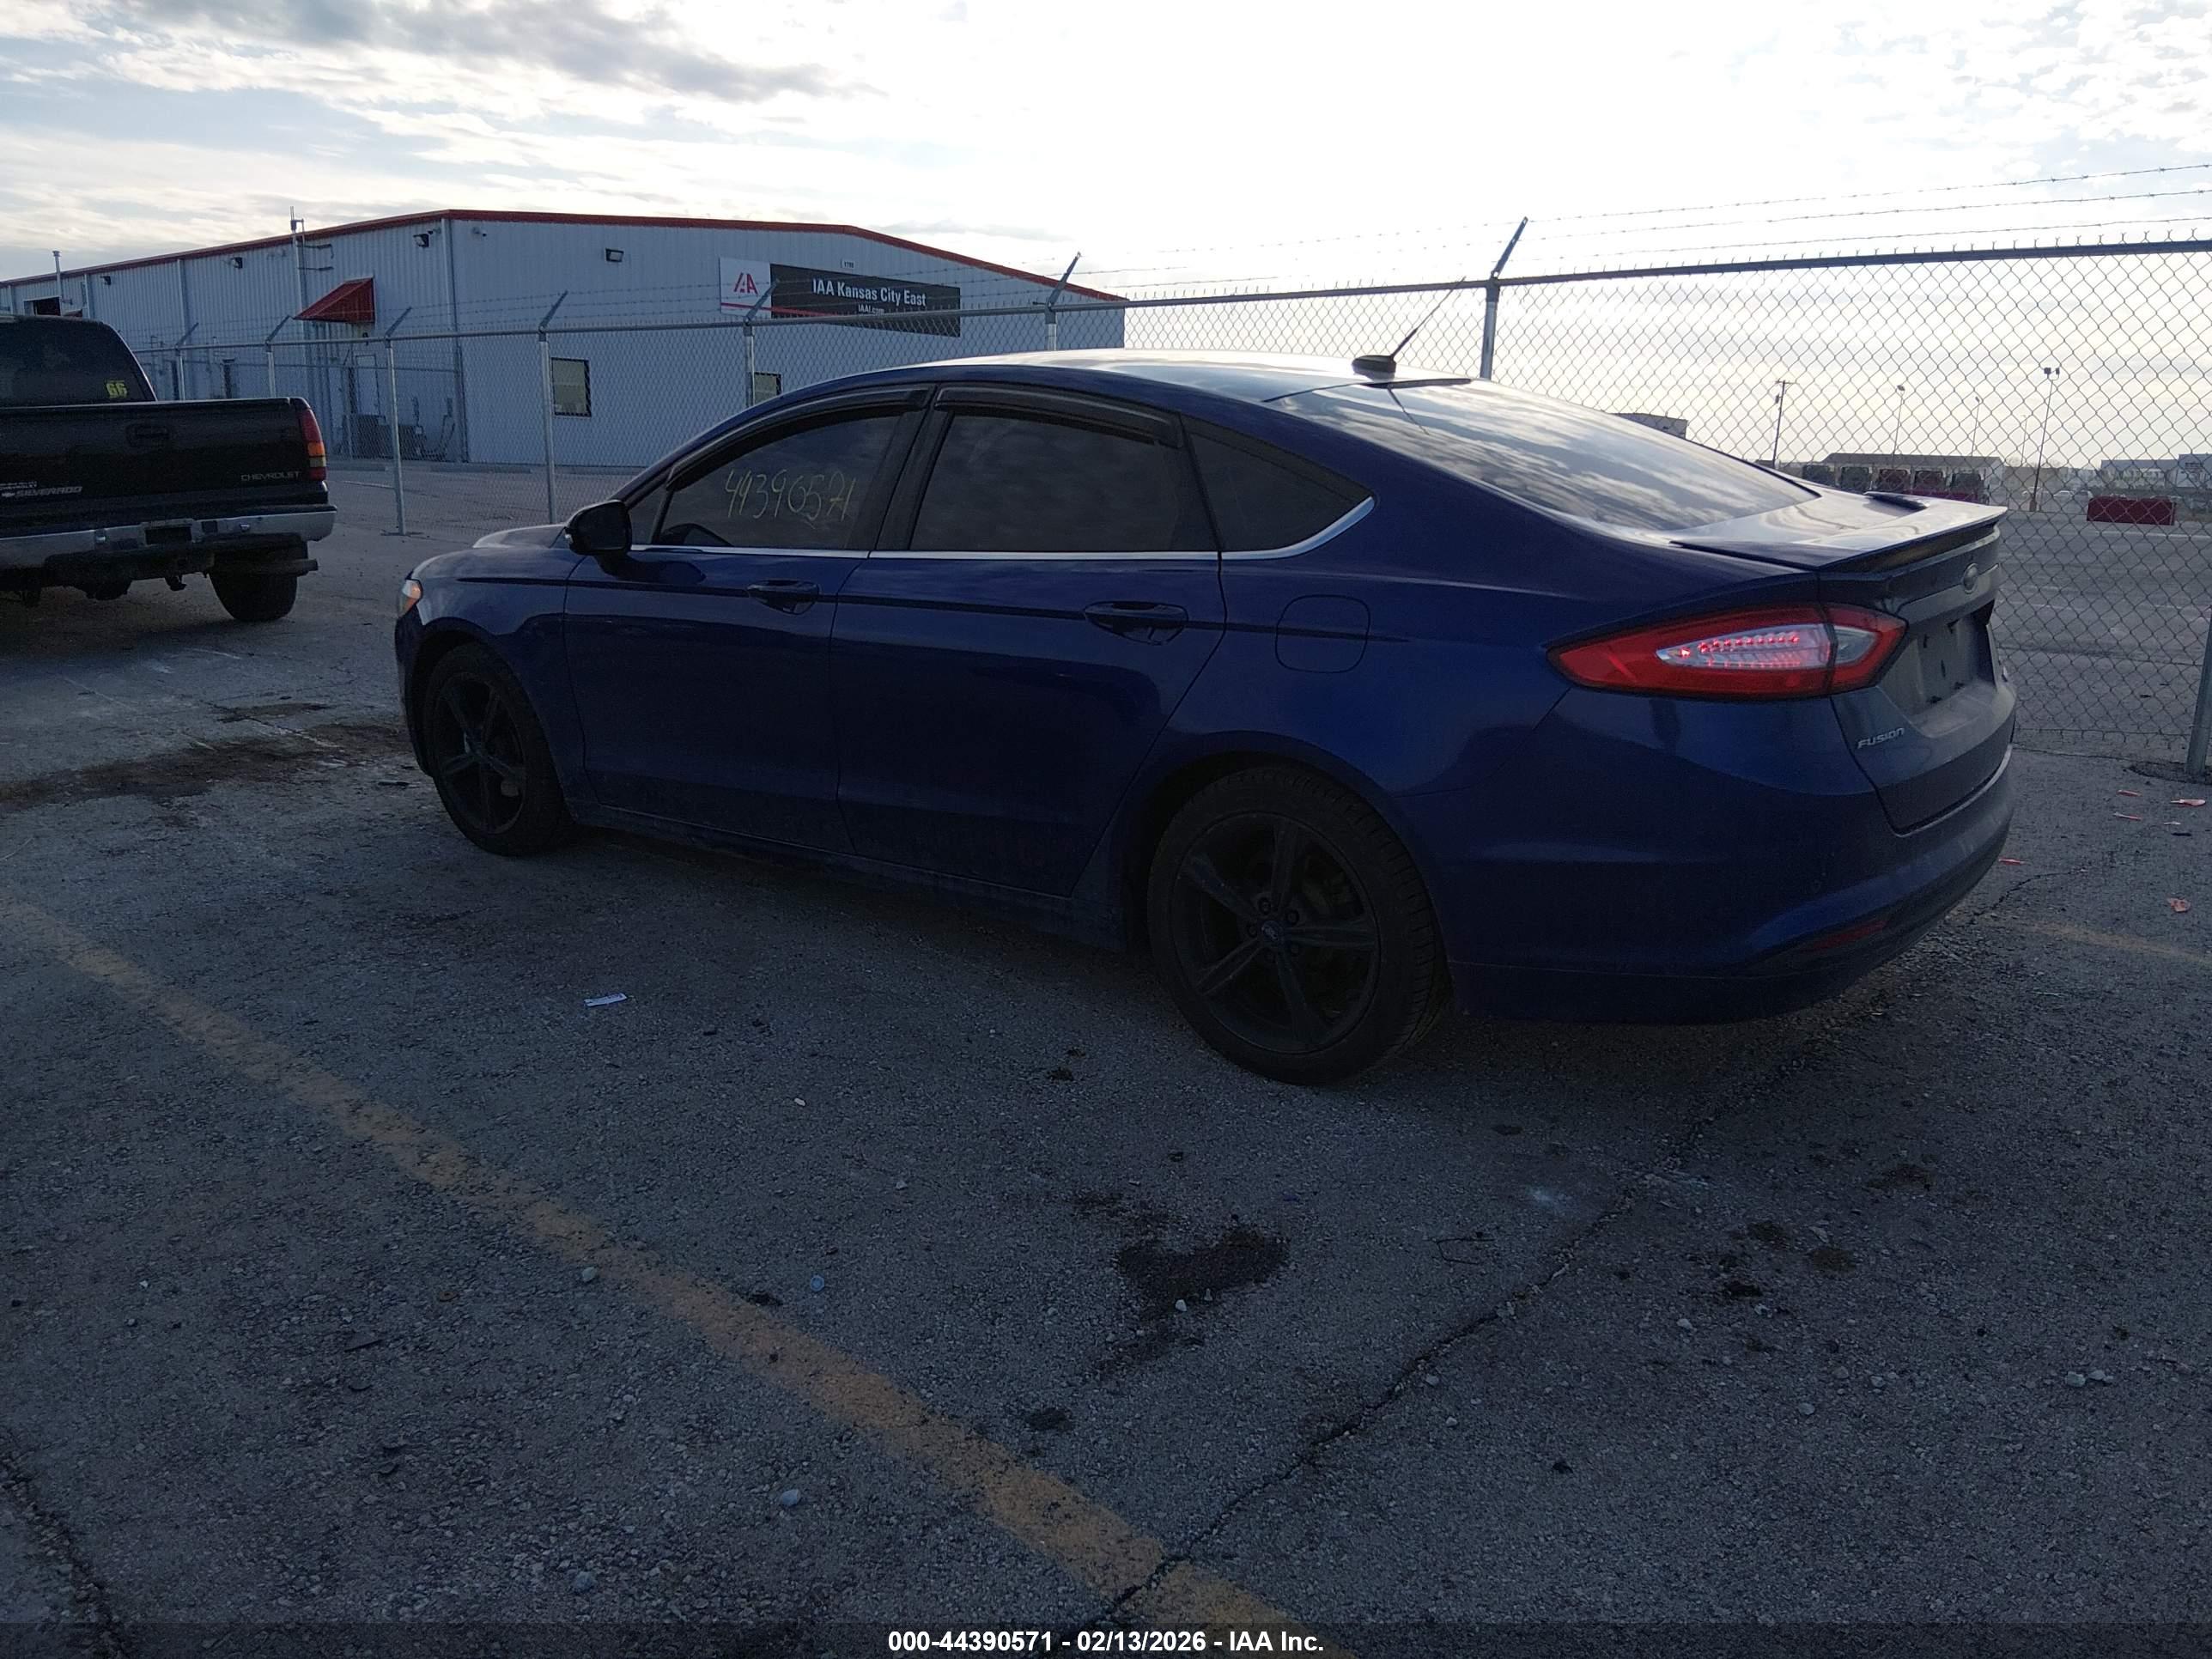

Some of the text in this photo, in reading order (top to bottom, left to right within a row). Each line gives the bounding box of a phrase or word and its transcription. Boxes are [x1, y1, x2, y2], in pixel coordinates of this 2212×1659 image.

[812, 278, 927, 307] IAA Kansas City East
[240, 471, 302, 482] CHEVROLET
[15, 486, 83, 497] SILVERADO
[1857, 727, 1905, 749] FUSION
